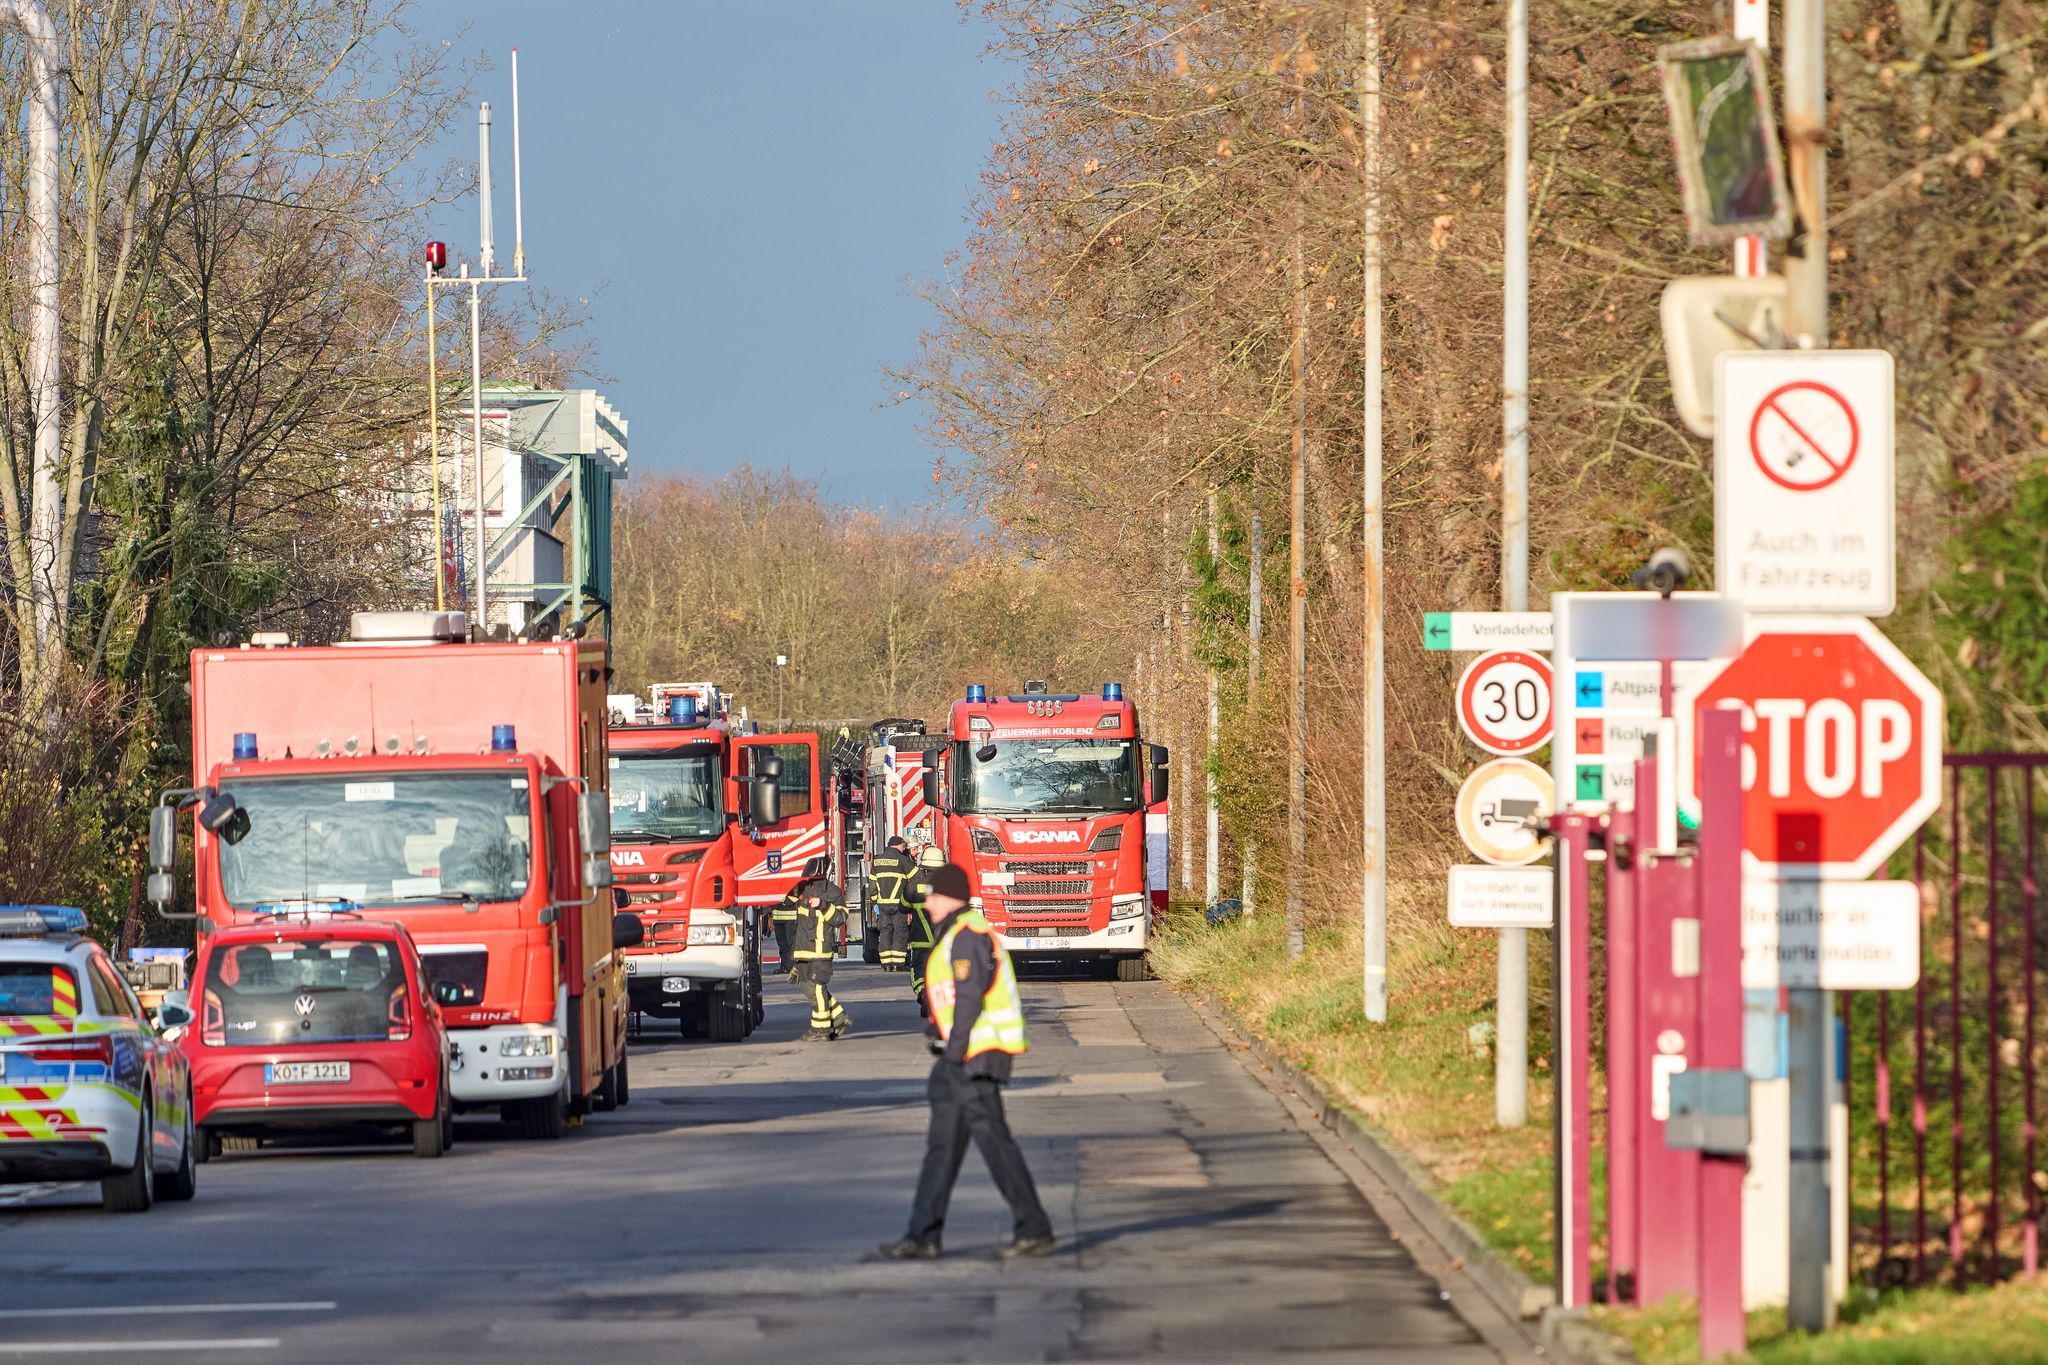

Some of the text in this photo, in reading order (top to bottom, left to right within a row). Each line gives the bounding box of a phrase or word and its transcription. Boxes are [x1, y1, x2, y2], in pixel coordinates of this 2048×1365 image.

[1750, 529, 1865, 552] Auch im
[1741, 562, 1871, 590] Fahrzeug
[1484, 680, 1537, 722] 30
[996, 727, 1094, 737] FEUERWEHR KOBLENZ
[761, 826, 807, 840] UFSFEUERWEHR
[1012, 830, 1081, 843] SCANIA
[611, 851, 645, 866] NIA
[470, 1011, 512, 1021] BINZ
[273, 1064, 292, 1080] KO
[301, 1064, 309, 1079] F
